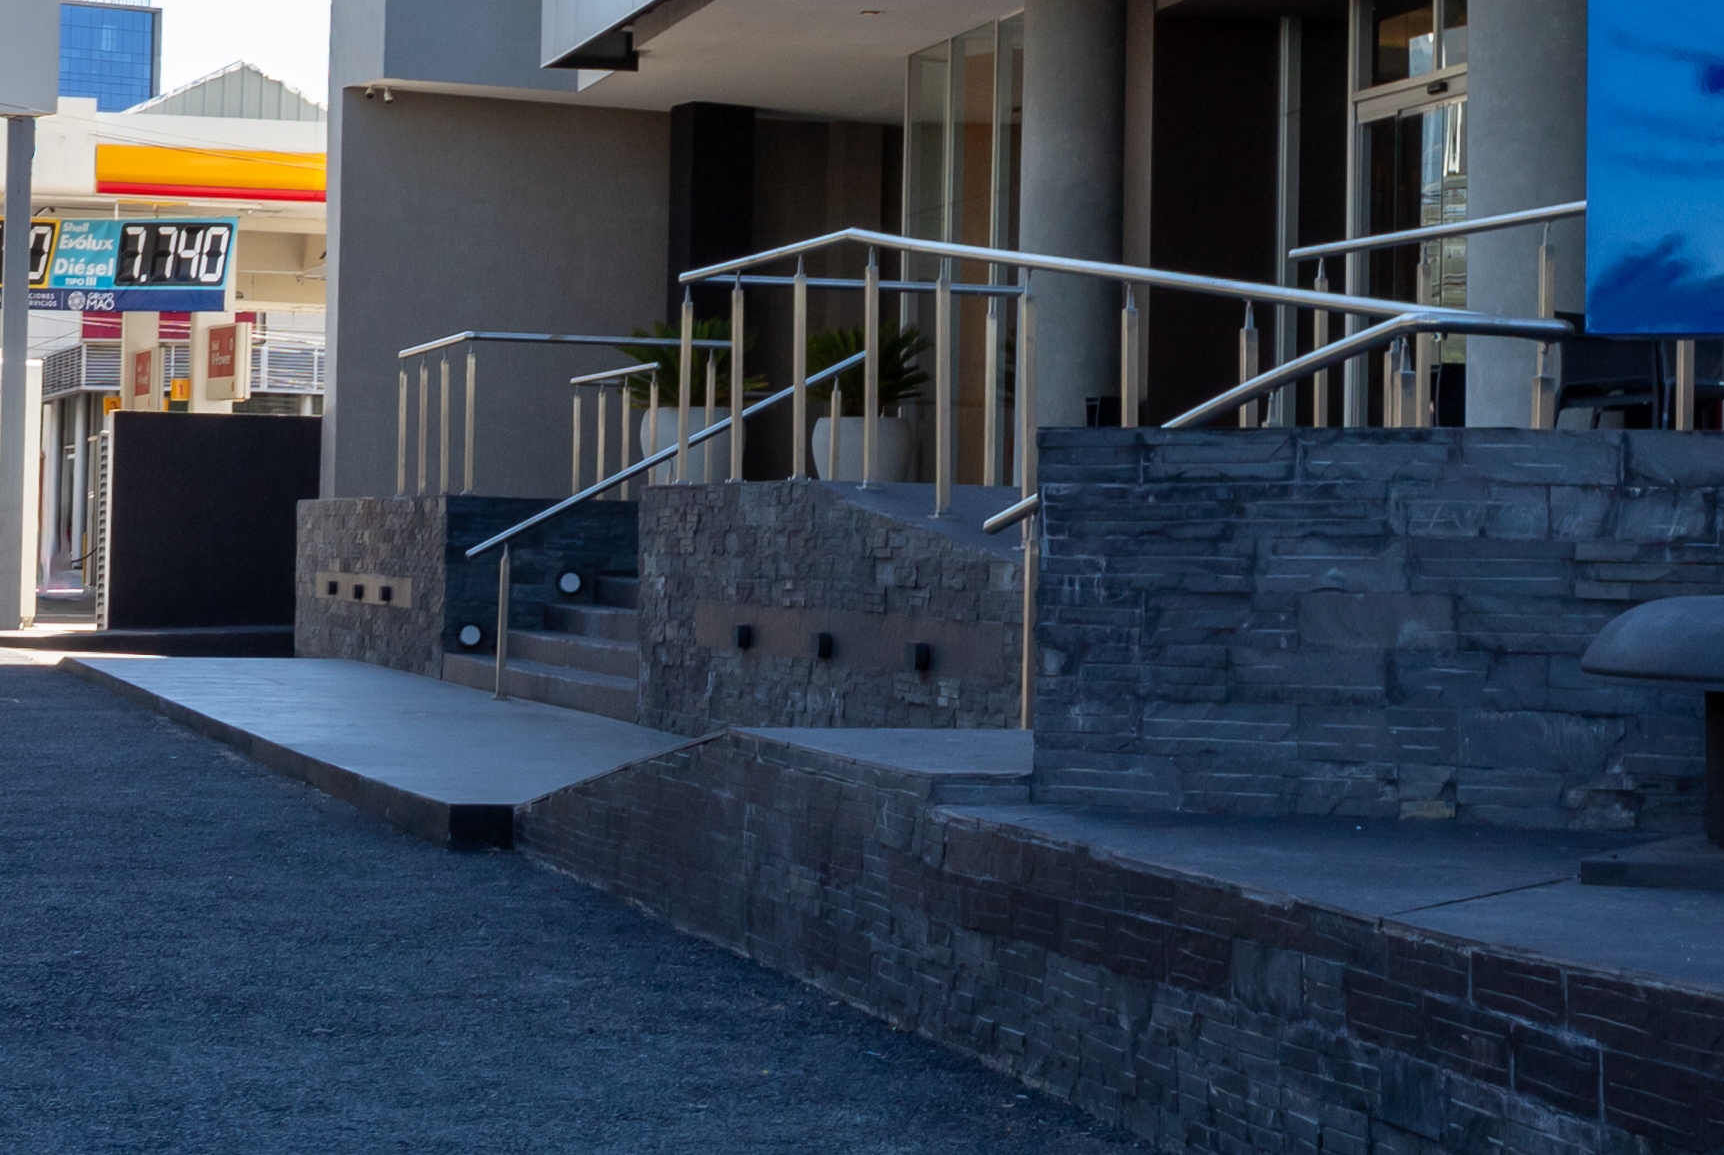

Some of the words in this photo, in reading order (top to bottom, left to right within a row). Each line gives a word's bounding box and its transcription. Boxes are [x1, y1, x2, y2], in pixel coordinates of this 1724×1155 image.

[62, 222, 90, 233] Shell
[125, 226, 230, 283] 7.740
[54, 257, 114, 276] Diésel
[65, 277, 84, 286] TIPO
[28, 292, 55, 300] CIONES
[86, 299, 115, 310] MAO
